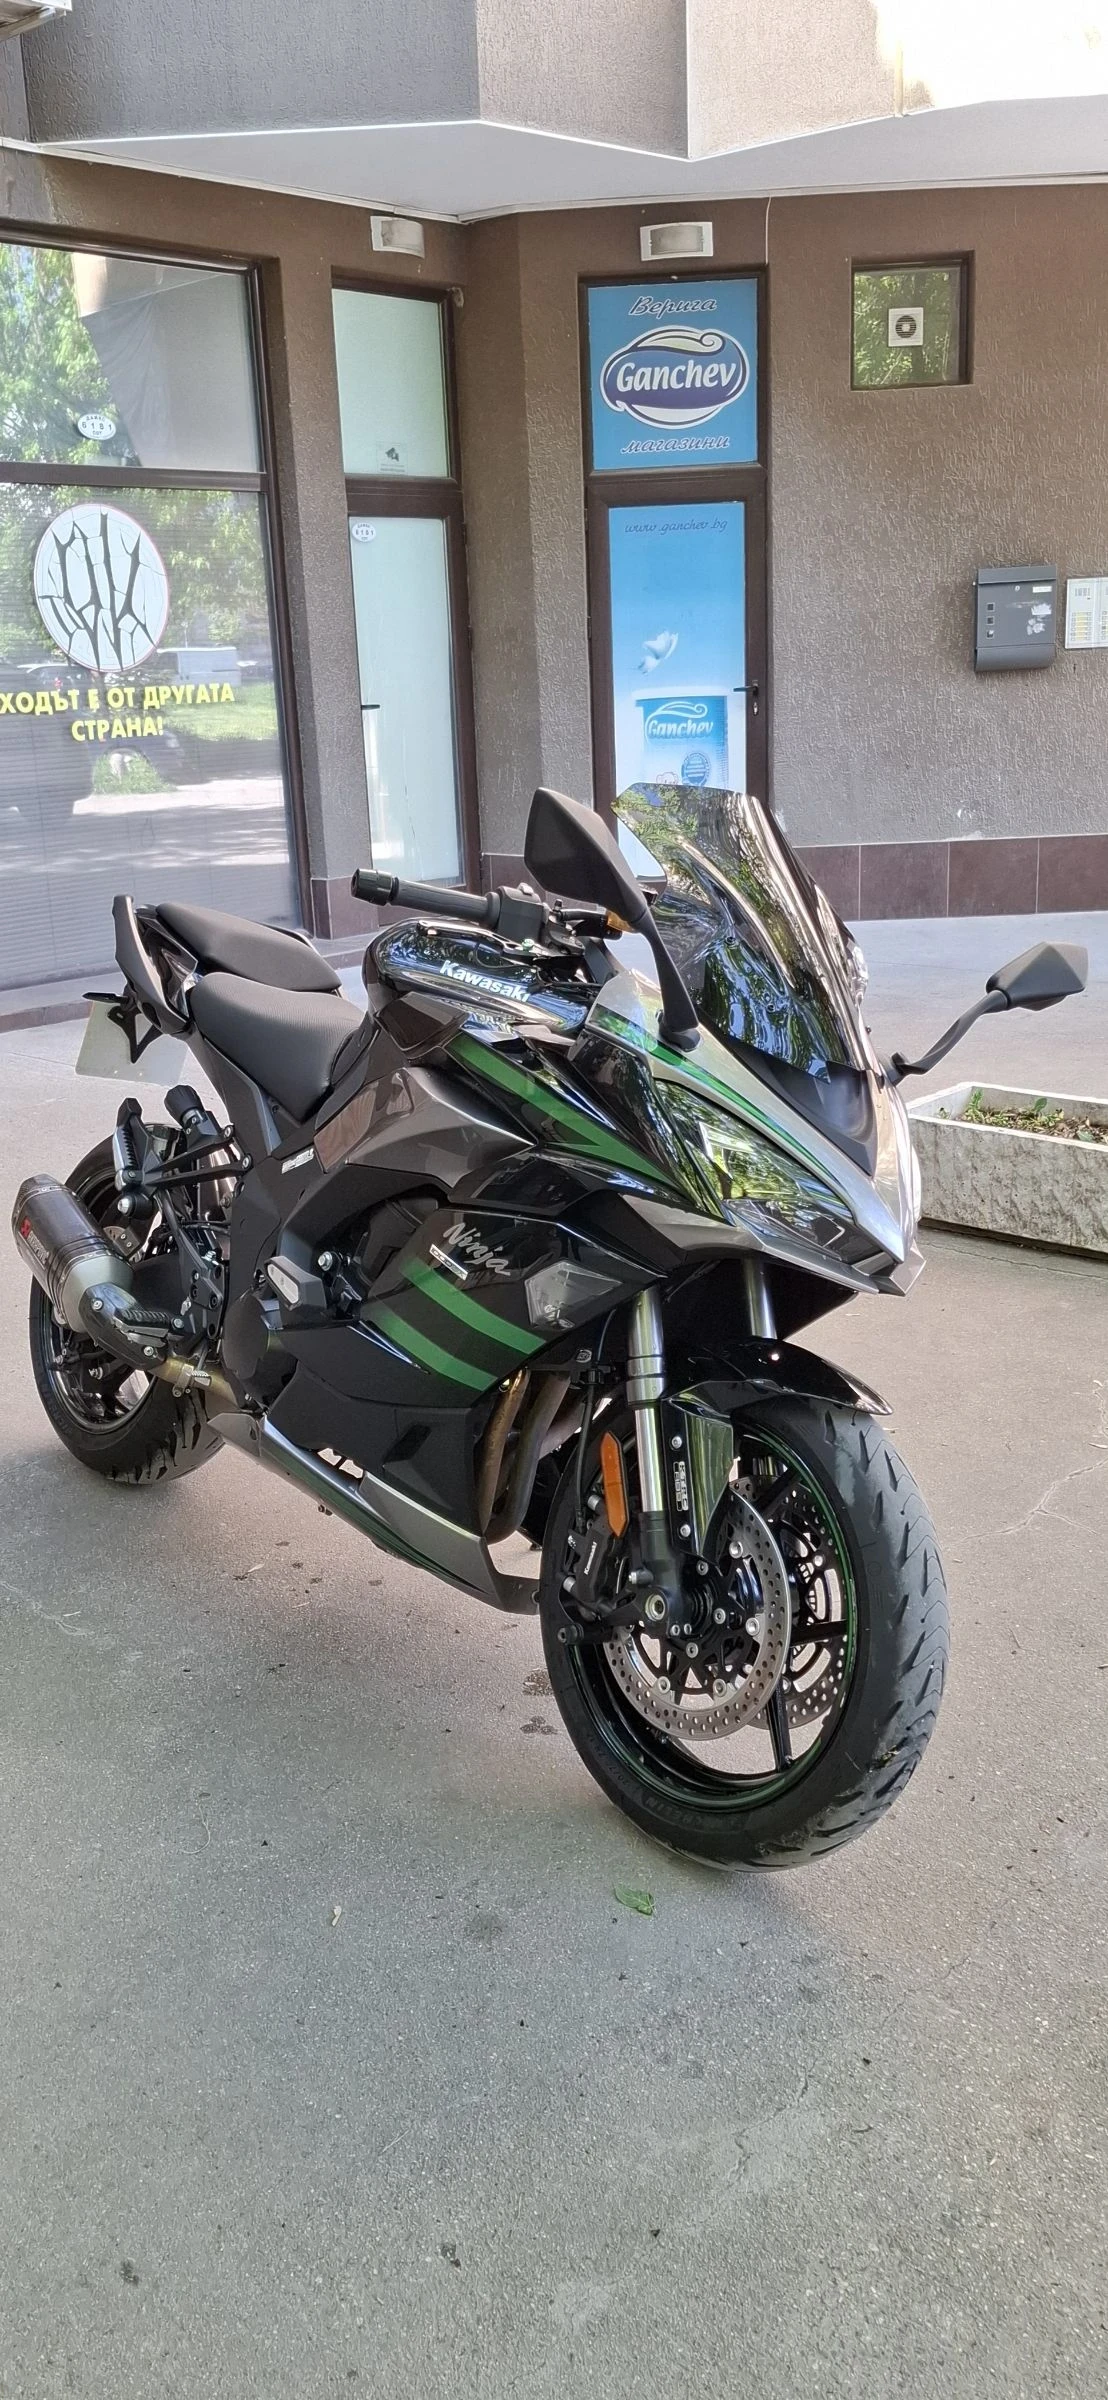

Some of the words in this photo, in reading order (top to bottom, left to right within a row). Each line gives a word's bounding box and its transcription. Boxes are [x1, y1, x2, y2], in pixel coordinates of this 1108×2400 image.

[630, 297, 716, 318] Верига
[617, 360, 736, 392] Ganchev
[621, 436, 729, 454] магазини
[625, 518, 728, 535] www.ganchev.bg
[88, 689, 99, 711] Е
[107, 687, 135, 708] ОТ
[143, 683, 235, 710] ДРУГАТА
[71, 717, 163, 741] СТРАНА!
[648, 719, 713, 738] Ganchev
[440, 960, 531, 1003] Kawasaki
[443, 1222, 511, 1276] Ninja
